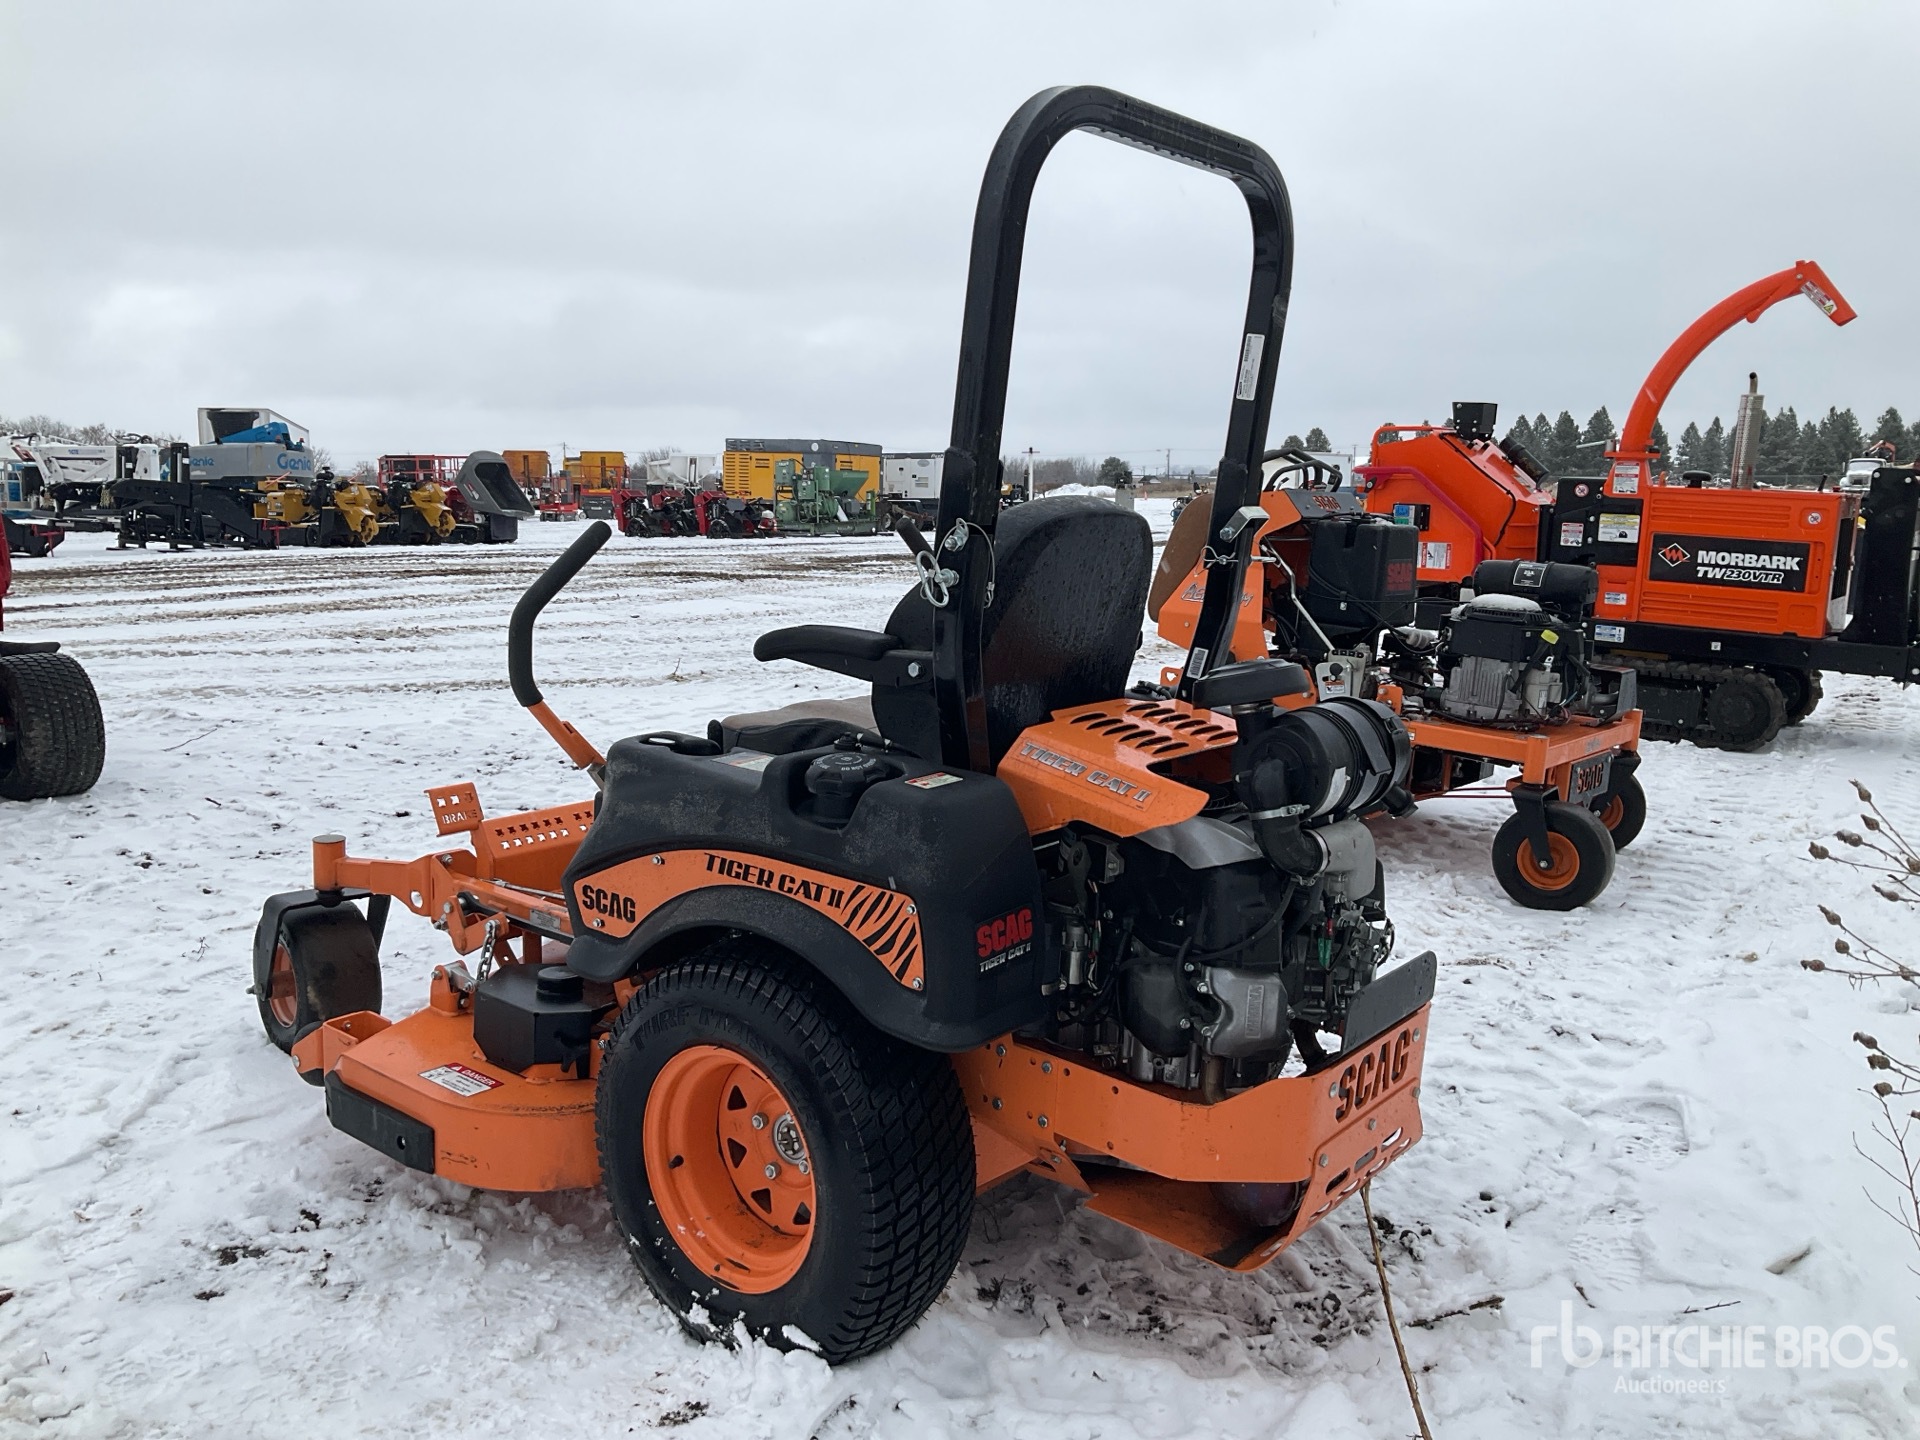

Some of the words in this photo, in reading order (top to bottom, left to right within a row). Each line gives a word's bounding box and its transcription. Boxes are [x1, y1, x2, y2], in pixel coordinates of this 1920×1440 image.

[189, 455, 214, 467] enie
[277, 452, 311, 471] Genie
[1697, 550, 1800, 571] MORBARK
[1020, 741, 1088, 777] TIGER
[1086, 769, 1138, 796] CAT
[1132, 788, 1152, 802] II
[1576, 762, 1604, 795] SCAG
[442, 809, 478, 824] BRAKE
[704, 852, 775, 890] TIGER
[777, 874, 829, 905] CAT
[829, 887, 844, 909] II
[582, 884, 636, 924] SCAG
[976, 908, 1033, 957] SCAG
[980, 952, 1007, 973] TIGER
[1007, 944, 1026, 960] CAT
[462, 1069, 496, 1086] DANGER
[1334, 1028, 1411, 1123] SCAG
